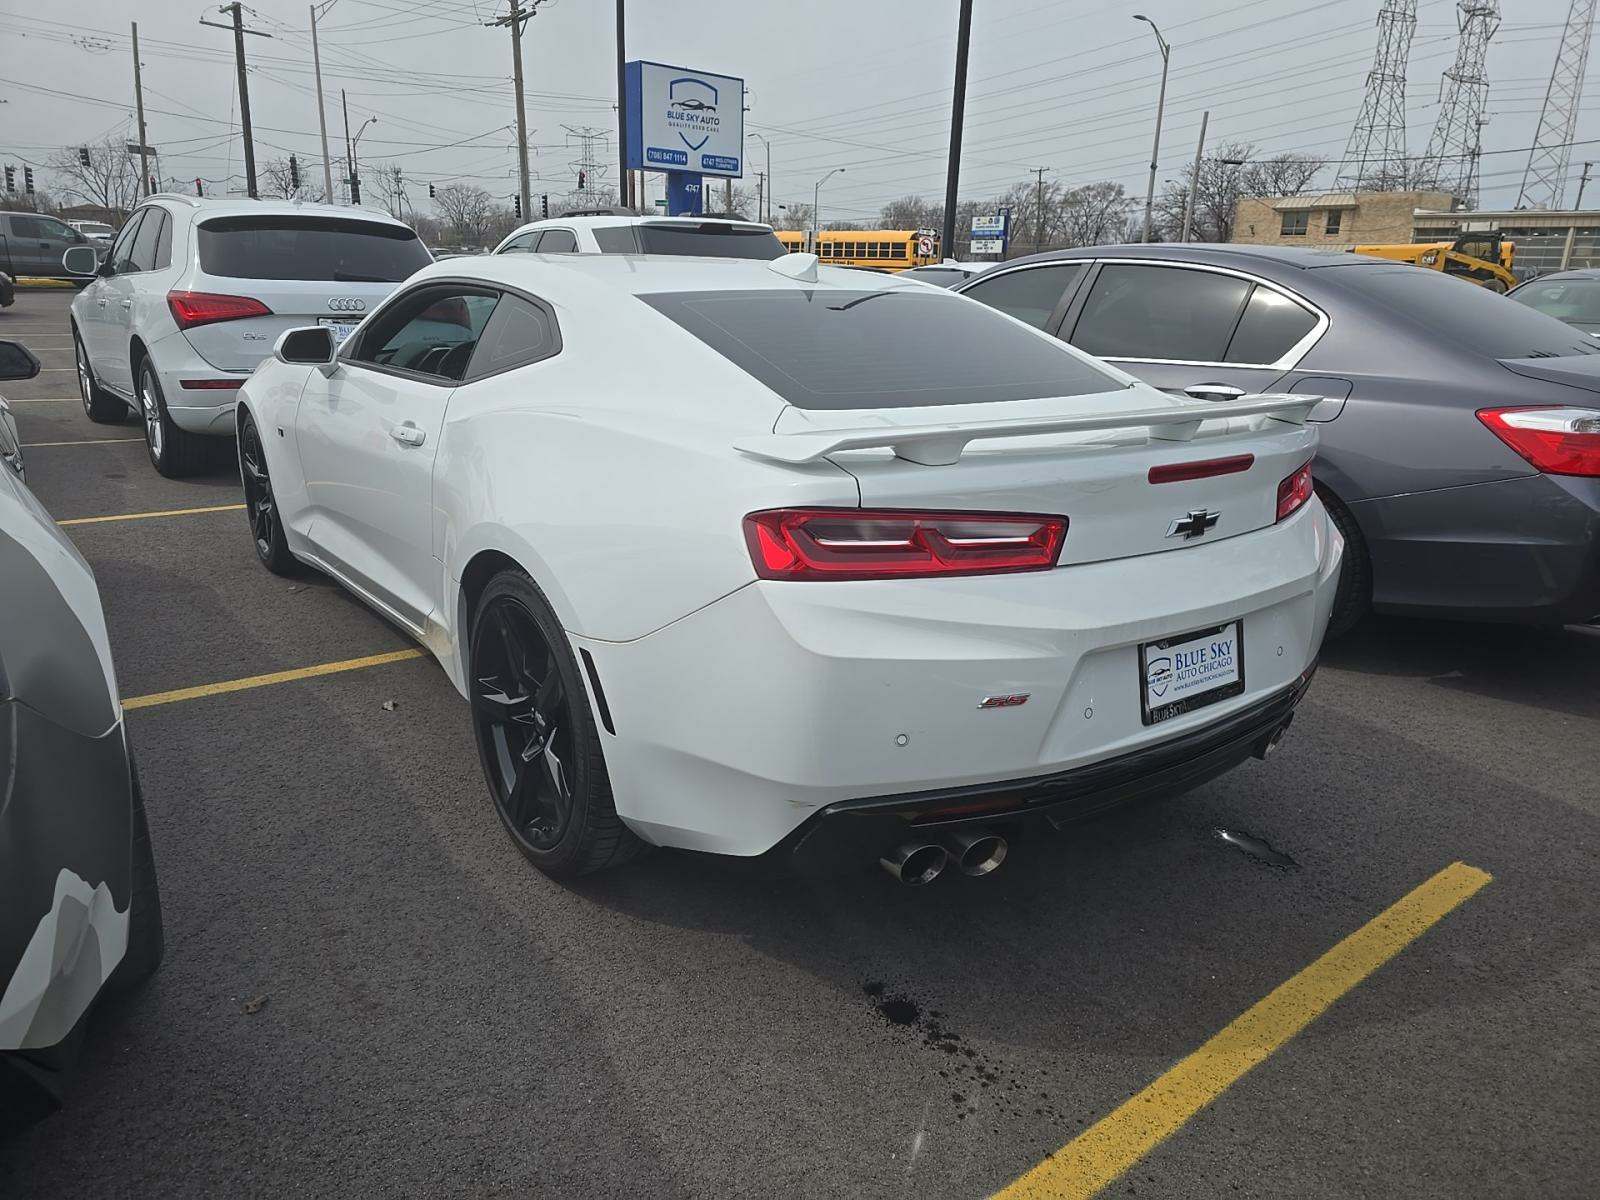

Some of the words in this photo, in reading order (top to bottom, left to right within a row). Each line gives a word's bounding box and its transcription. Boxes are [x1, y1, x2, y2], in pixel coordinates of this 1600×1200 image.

[667, 110, 685, 121] BLUE
[686, 112, 700, 123] SKY
[700, 116, 720, 126] AUTO
[674, 153, 686, 163] 1114
[703, 157, 715, 165] 4747
[685, 183, 700, 193] 4747
[1422, 255, 1436, 265] CAT
[1175, 647, 1207, 671] BLUE
[1210, 639, 1233, 660] SKY
[1176, 666, 1197, 682] AUTO
[1198, 656, 1233, 675] CHICAGO
